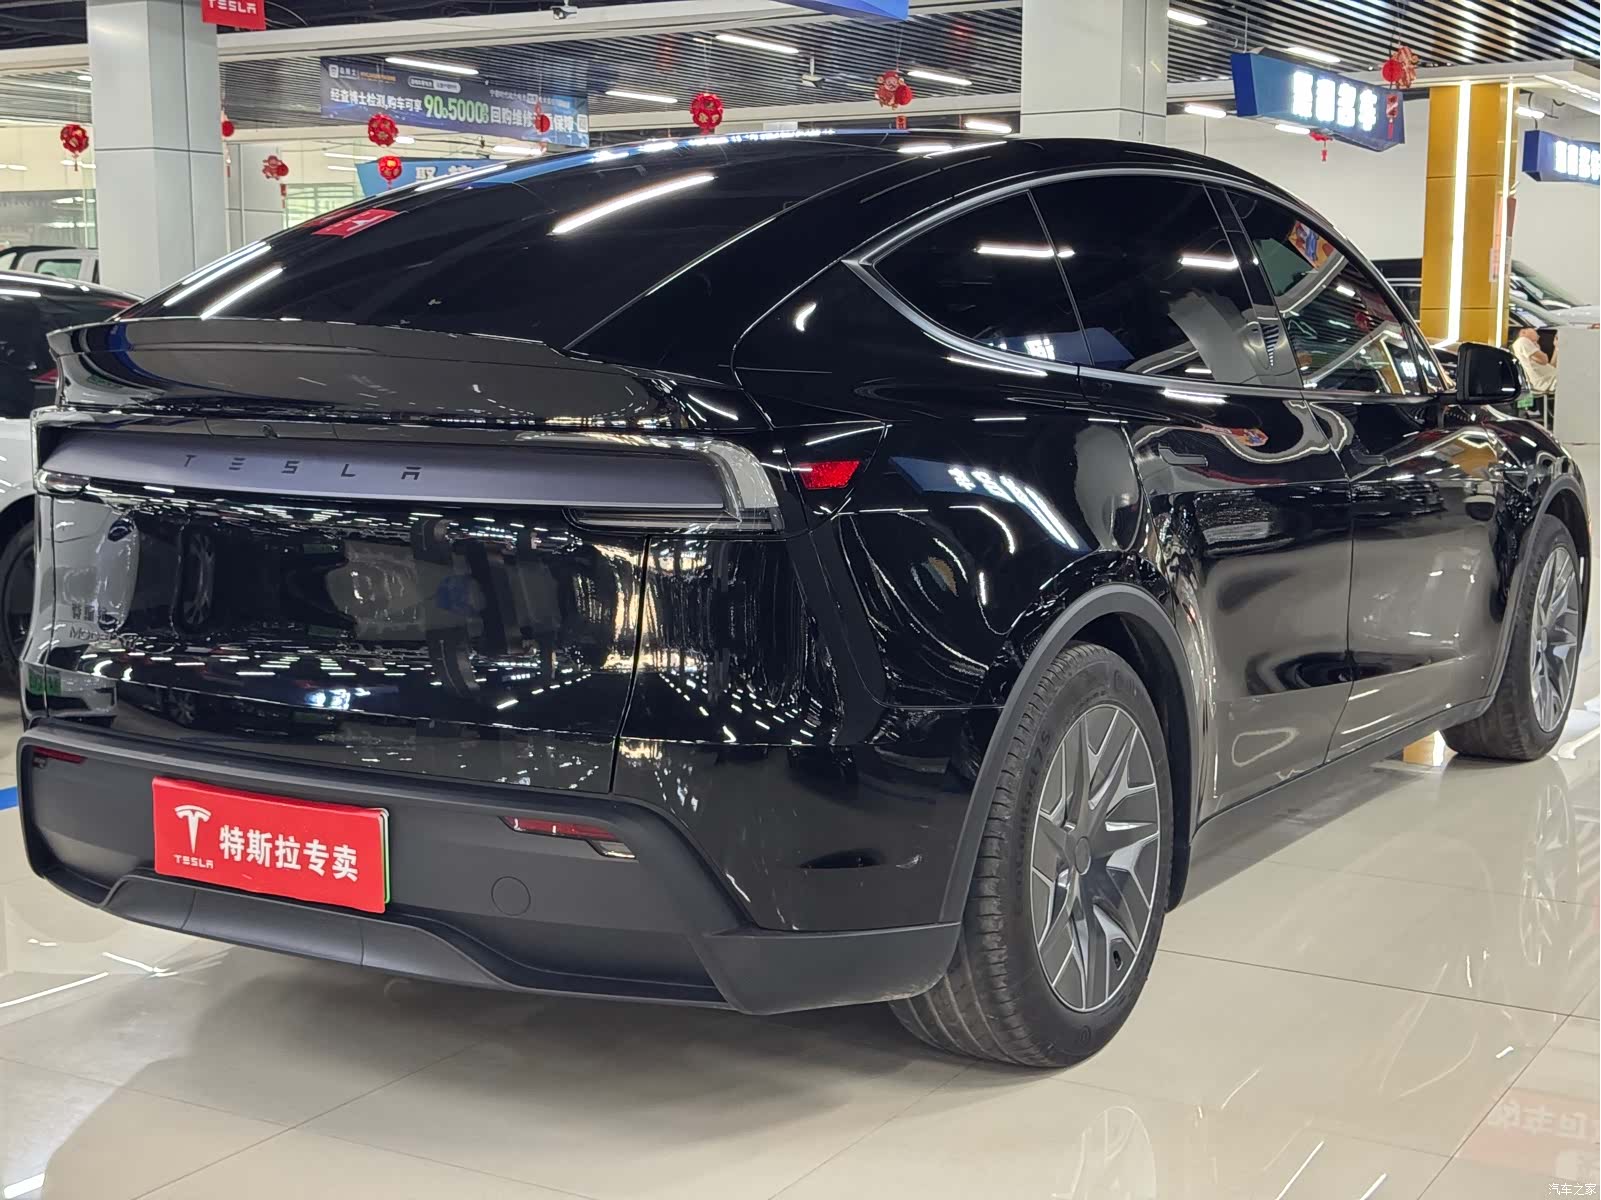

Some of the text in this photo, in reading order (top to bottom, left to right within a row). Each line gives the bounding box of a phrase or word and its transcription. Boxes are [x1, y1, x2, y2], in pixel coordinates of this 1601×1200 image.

[208, 0, 257, 14] TESLA
[184, 454, 422, 480] TESLA
[173, 854, 214, 869] TESLA
[219, 824, 359, 882] 特斯拉专卖
